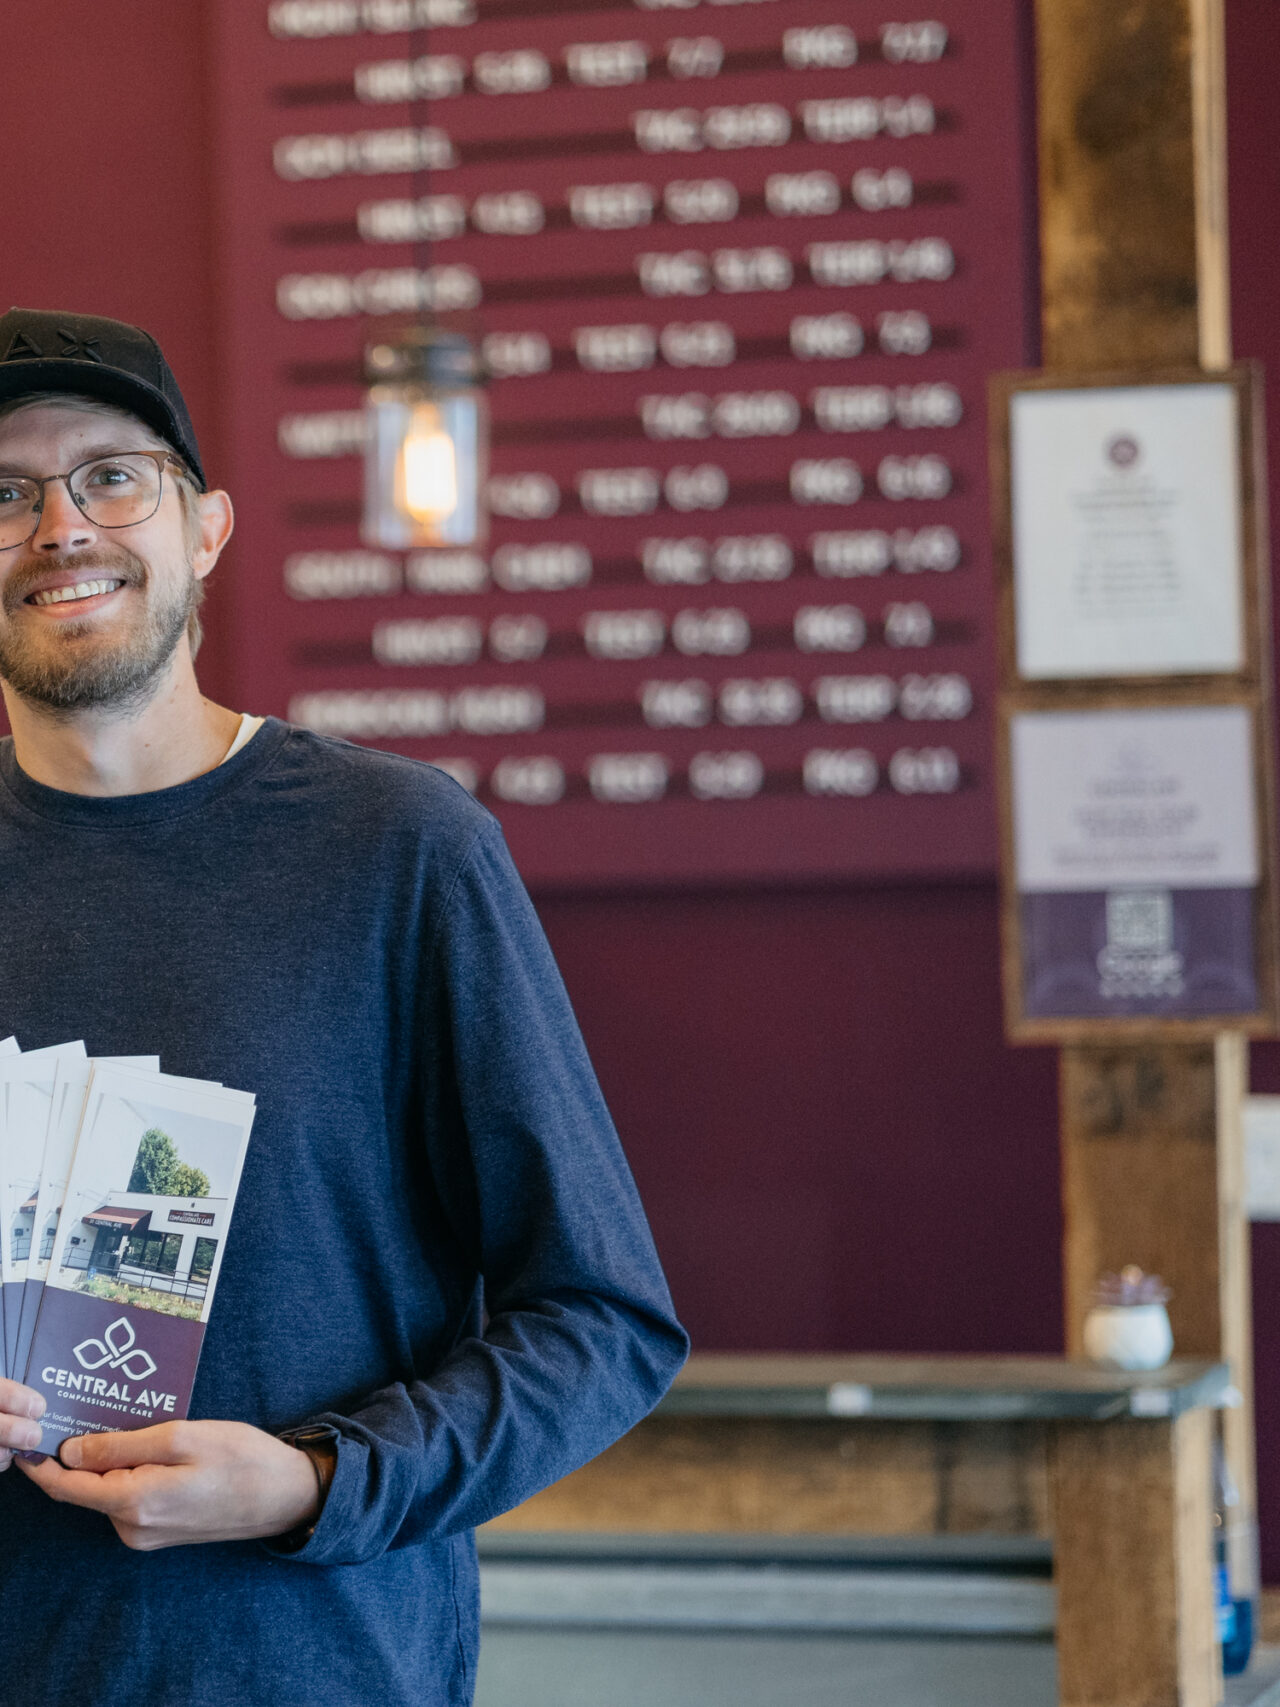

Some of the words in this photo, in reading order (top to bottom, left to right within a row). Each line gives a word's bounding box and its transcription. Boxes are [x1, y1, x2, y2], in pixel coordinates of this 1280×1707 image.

[42, 1366, 131, 1402] CENTRAL
[135, 1389, 177, 1412] AVE
[57, 1390, 127, 1412] COMPASSIONATE
[130, 1407, 153, 1418] CARE
[39, 1420, 76, 1435] dispensary
[52, 1411, 75, 1425] locally
[76, 1419, 101, 1430] owned
